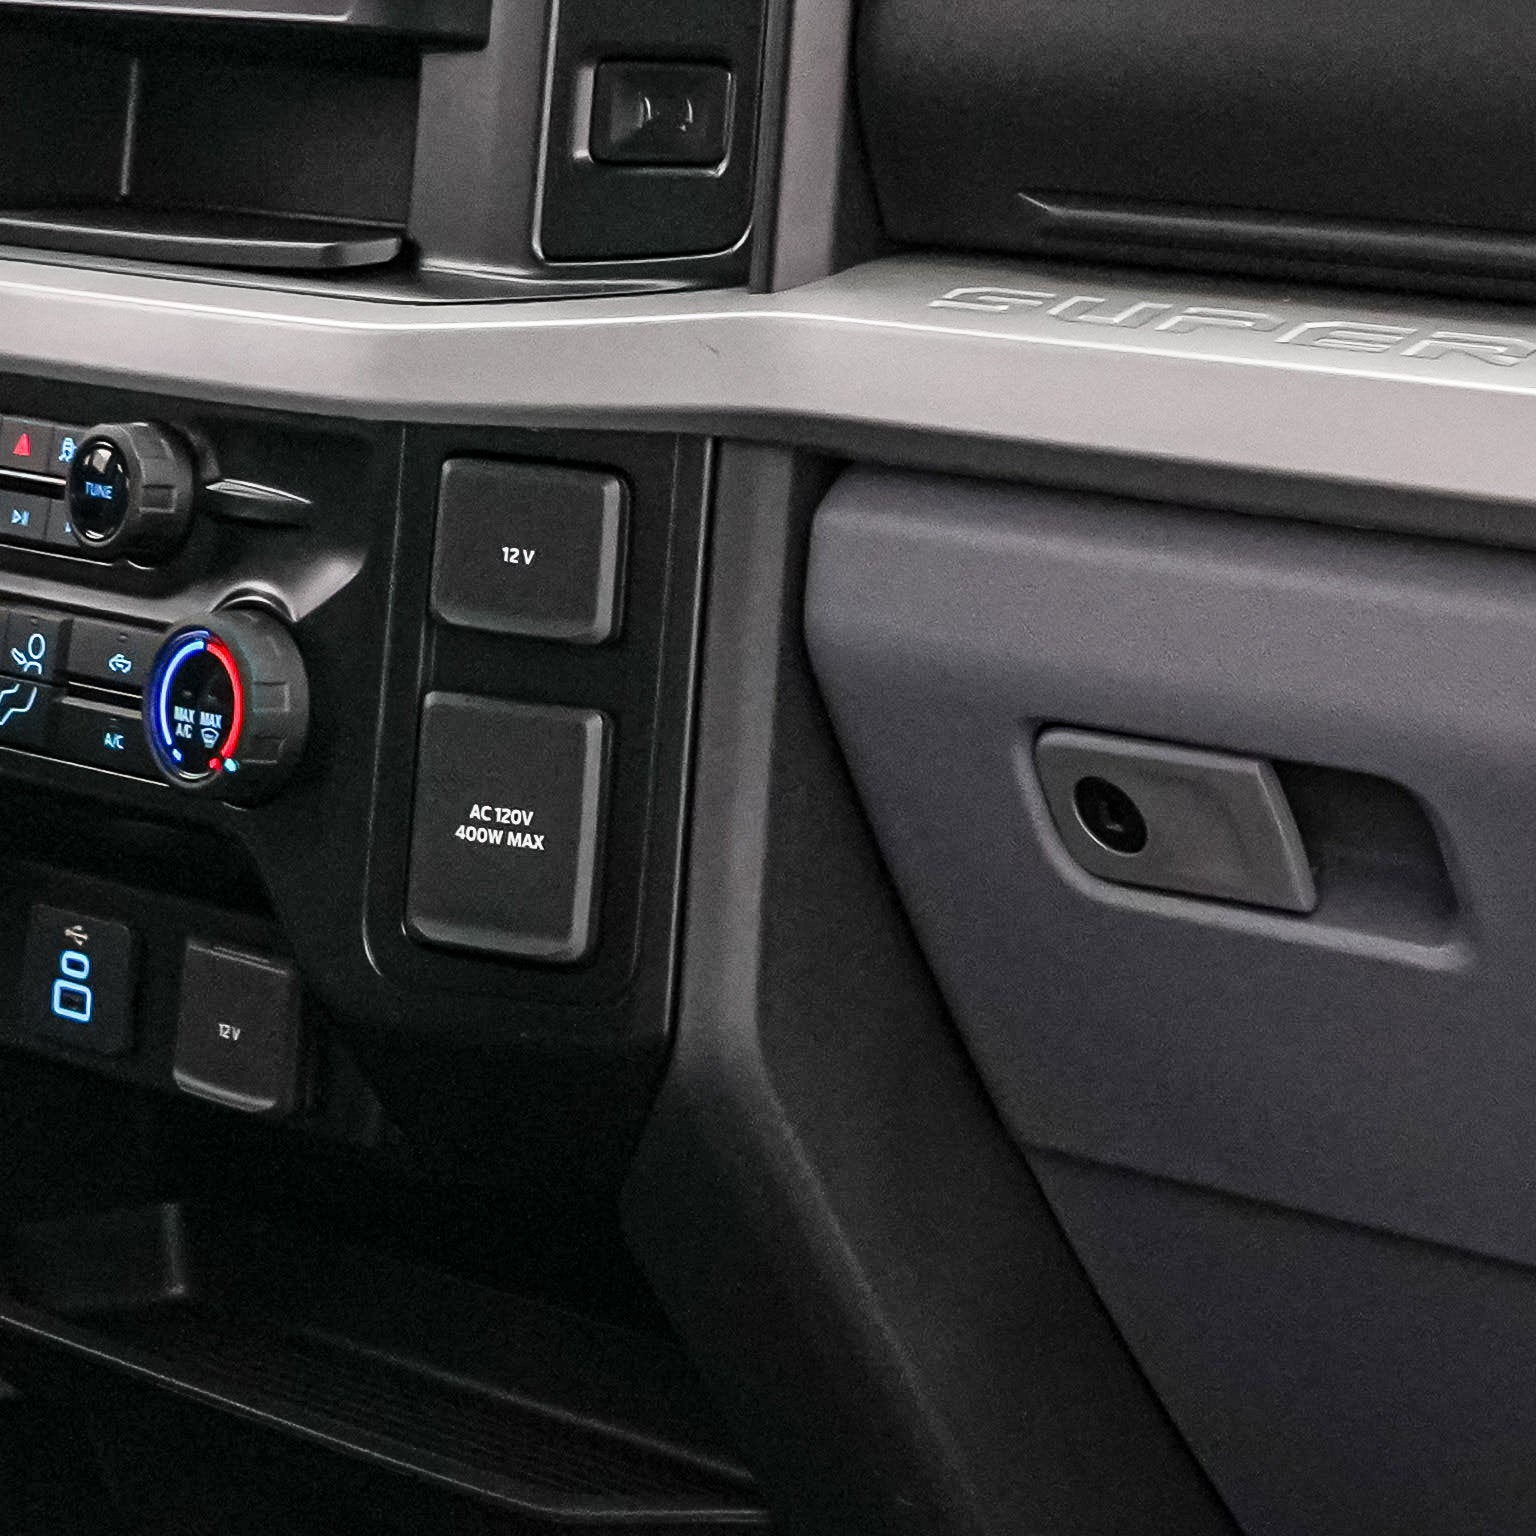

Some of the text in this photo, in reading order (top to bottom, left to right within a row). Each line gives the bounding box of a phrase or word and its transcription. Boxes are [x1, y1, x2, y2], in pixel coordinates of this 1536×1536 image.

[501, 546, 520, 564] 12
[173, 705, 196, 725] MAX
[199, 710, 223, 730] MAX
[469, 803, 534, 826] AC 120V
[454, 824, 545, 851] 400W MAX
